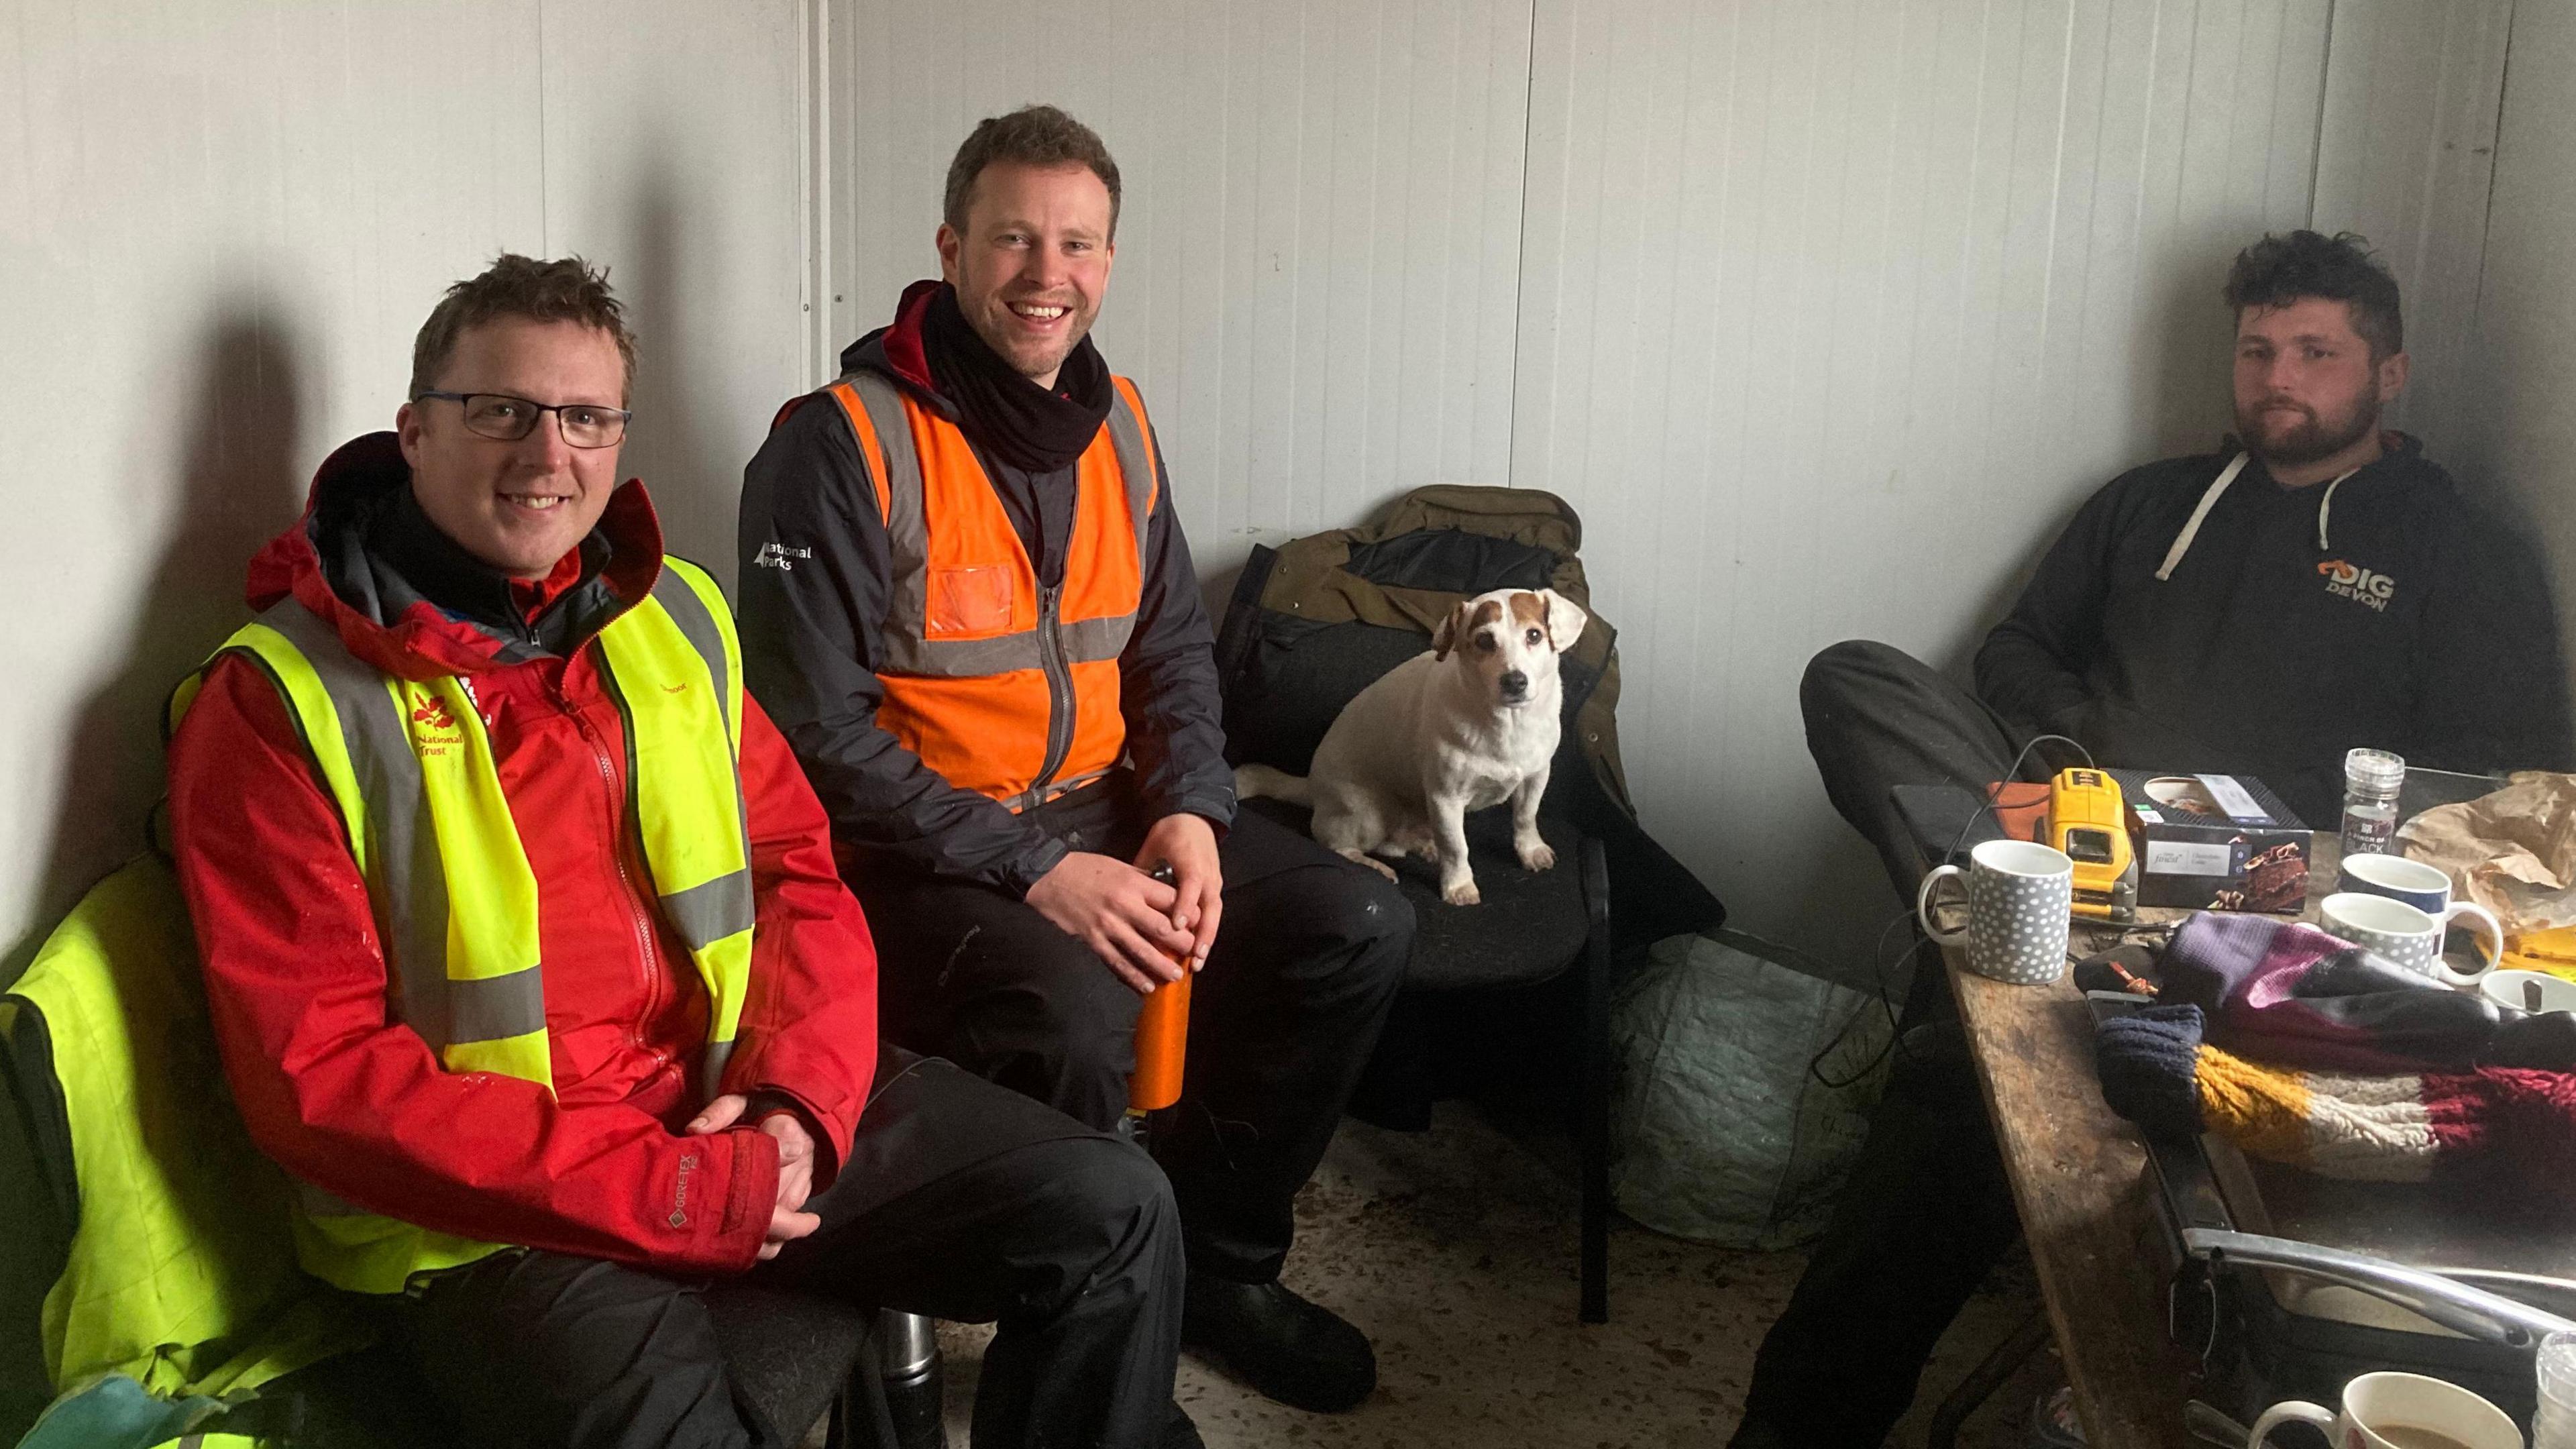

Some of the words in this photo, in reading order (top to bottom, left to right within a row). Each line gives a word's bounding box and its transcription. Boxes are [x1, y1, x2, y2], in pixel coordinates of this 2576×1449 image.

[765, 542, 812, 559] National
[764, 556, 792, 571] Parks
[2330, 564, 2395, 598] DIG
[2325, 582, 2388, 612] DEVON
[418, 733, 464, 744] National
[419, 745, 446, 757] Trust
